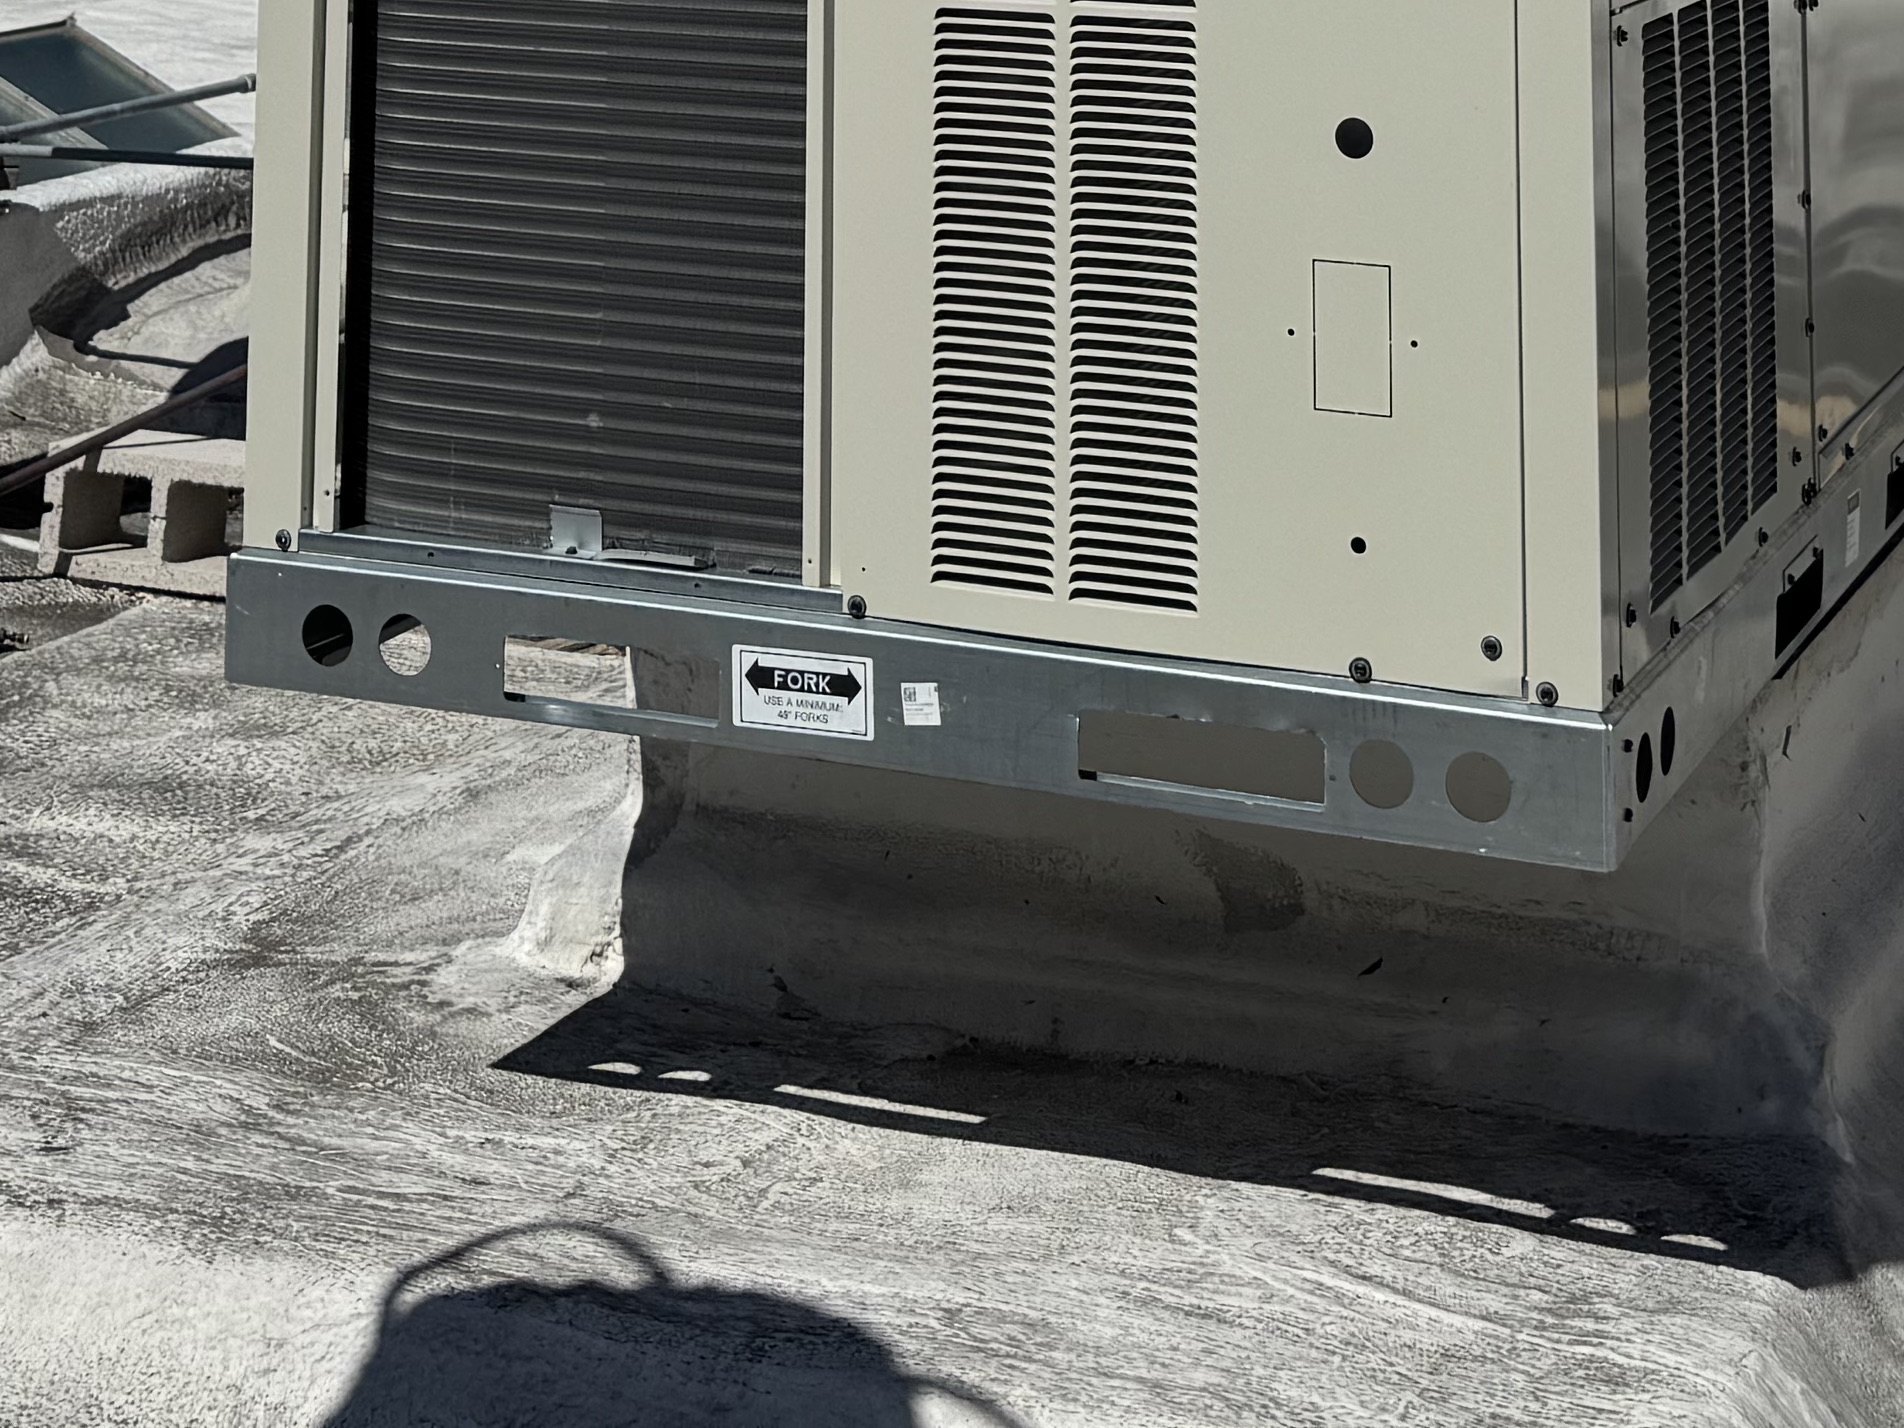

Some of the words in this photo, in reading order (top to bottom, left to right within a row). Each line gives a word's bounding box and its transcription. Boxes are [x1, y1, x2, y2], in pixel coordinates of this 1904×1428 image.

[773, 669, 832, 694] FORK
[763, 695, 783, 706] USE
[786, 697, 793, 707] A
[794, 711, 829, 724] FORKS
